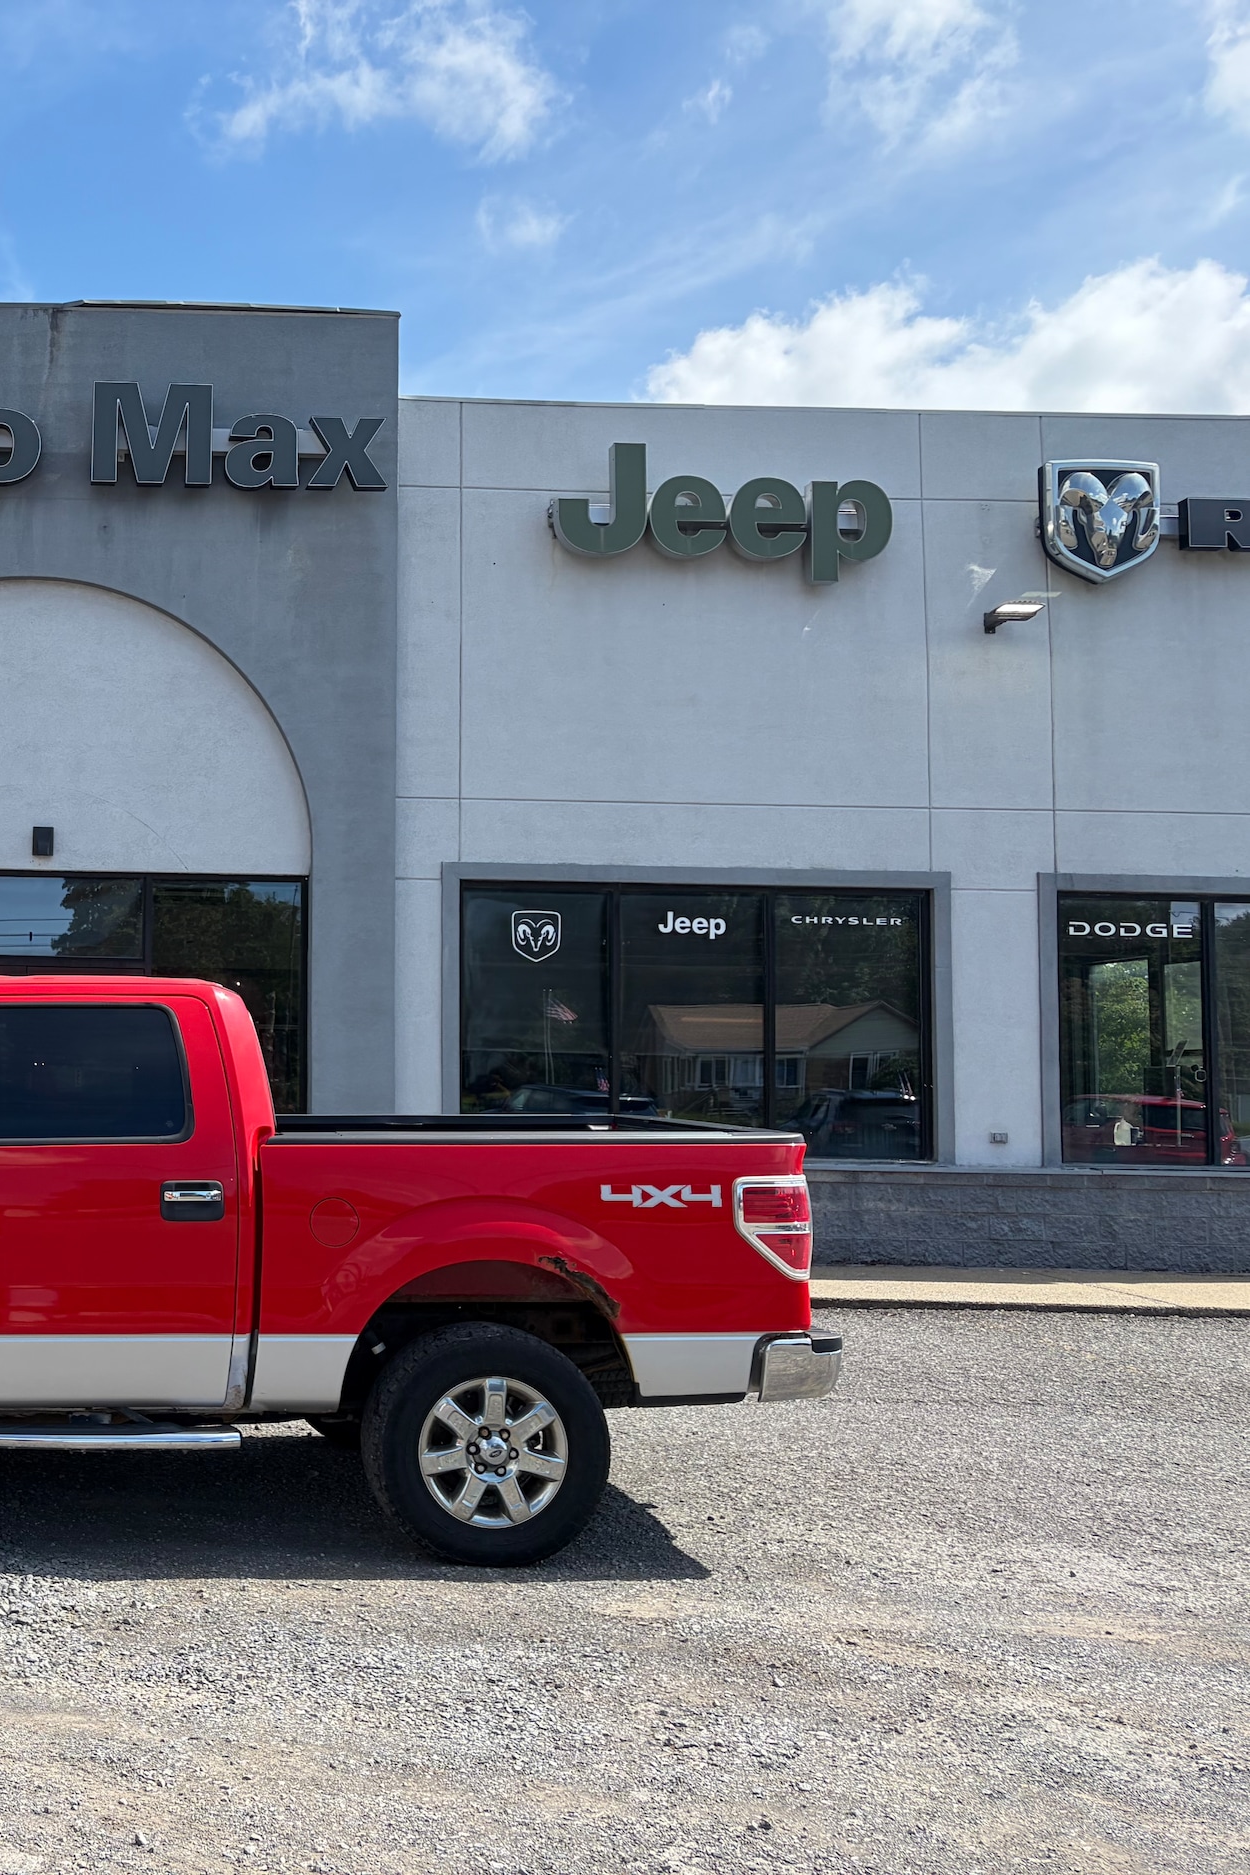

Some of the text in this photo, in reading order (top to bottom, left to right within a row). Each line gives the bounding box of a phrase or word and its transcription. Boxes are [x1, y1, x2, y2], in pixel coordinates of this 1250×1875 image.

[91, 380, 389, 491] Max
[552, 442, 893, 585] Jeep
[658, 911, 727, 940] Jeep
[790, 915, 903, 927] CHRYSLER
[1068, 921, 1194, 939] DODGE
